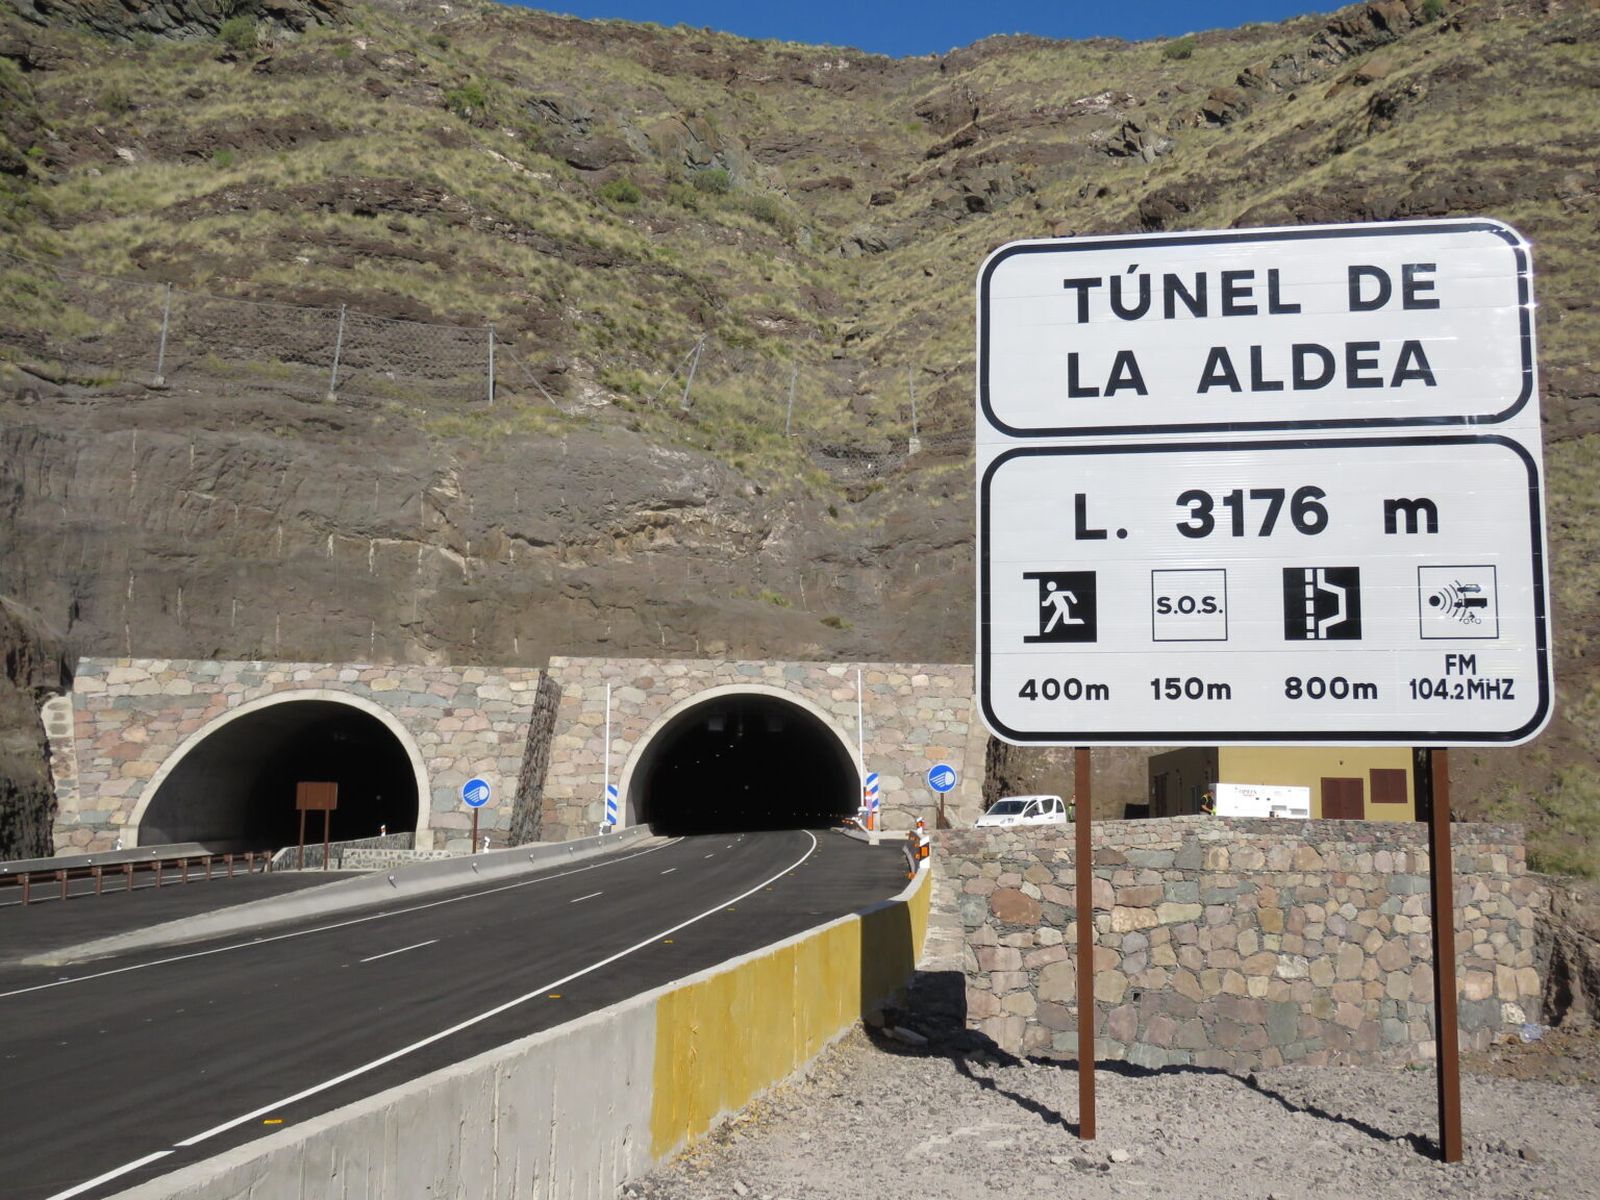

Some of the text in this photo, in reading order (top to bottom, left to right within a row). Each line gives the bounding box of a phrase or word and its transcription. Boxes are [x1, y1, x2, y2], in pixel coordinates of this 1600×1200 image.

[1063, 262, 1441, 324] TÚNEL DE
[1067, 339, 1437, 399] LA ALDEA
[1074, 485, 1439, 540] L. 3176 m
[1156, 595, 1224, 615] S.O.S.
[1445, 653, 1477, 676] FM
[1018, 677, 1110, 701] 400m
[1150, 676, 1232, 701] 150m
[1284, 676, 1378, 700] 800m
